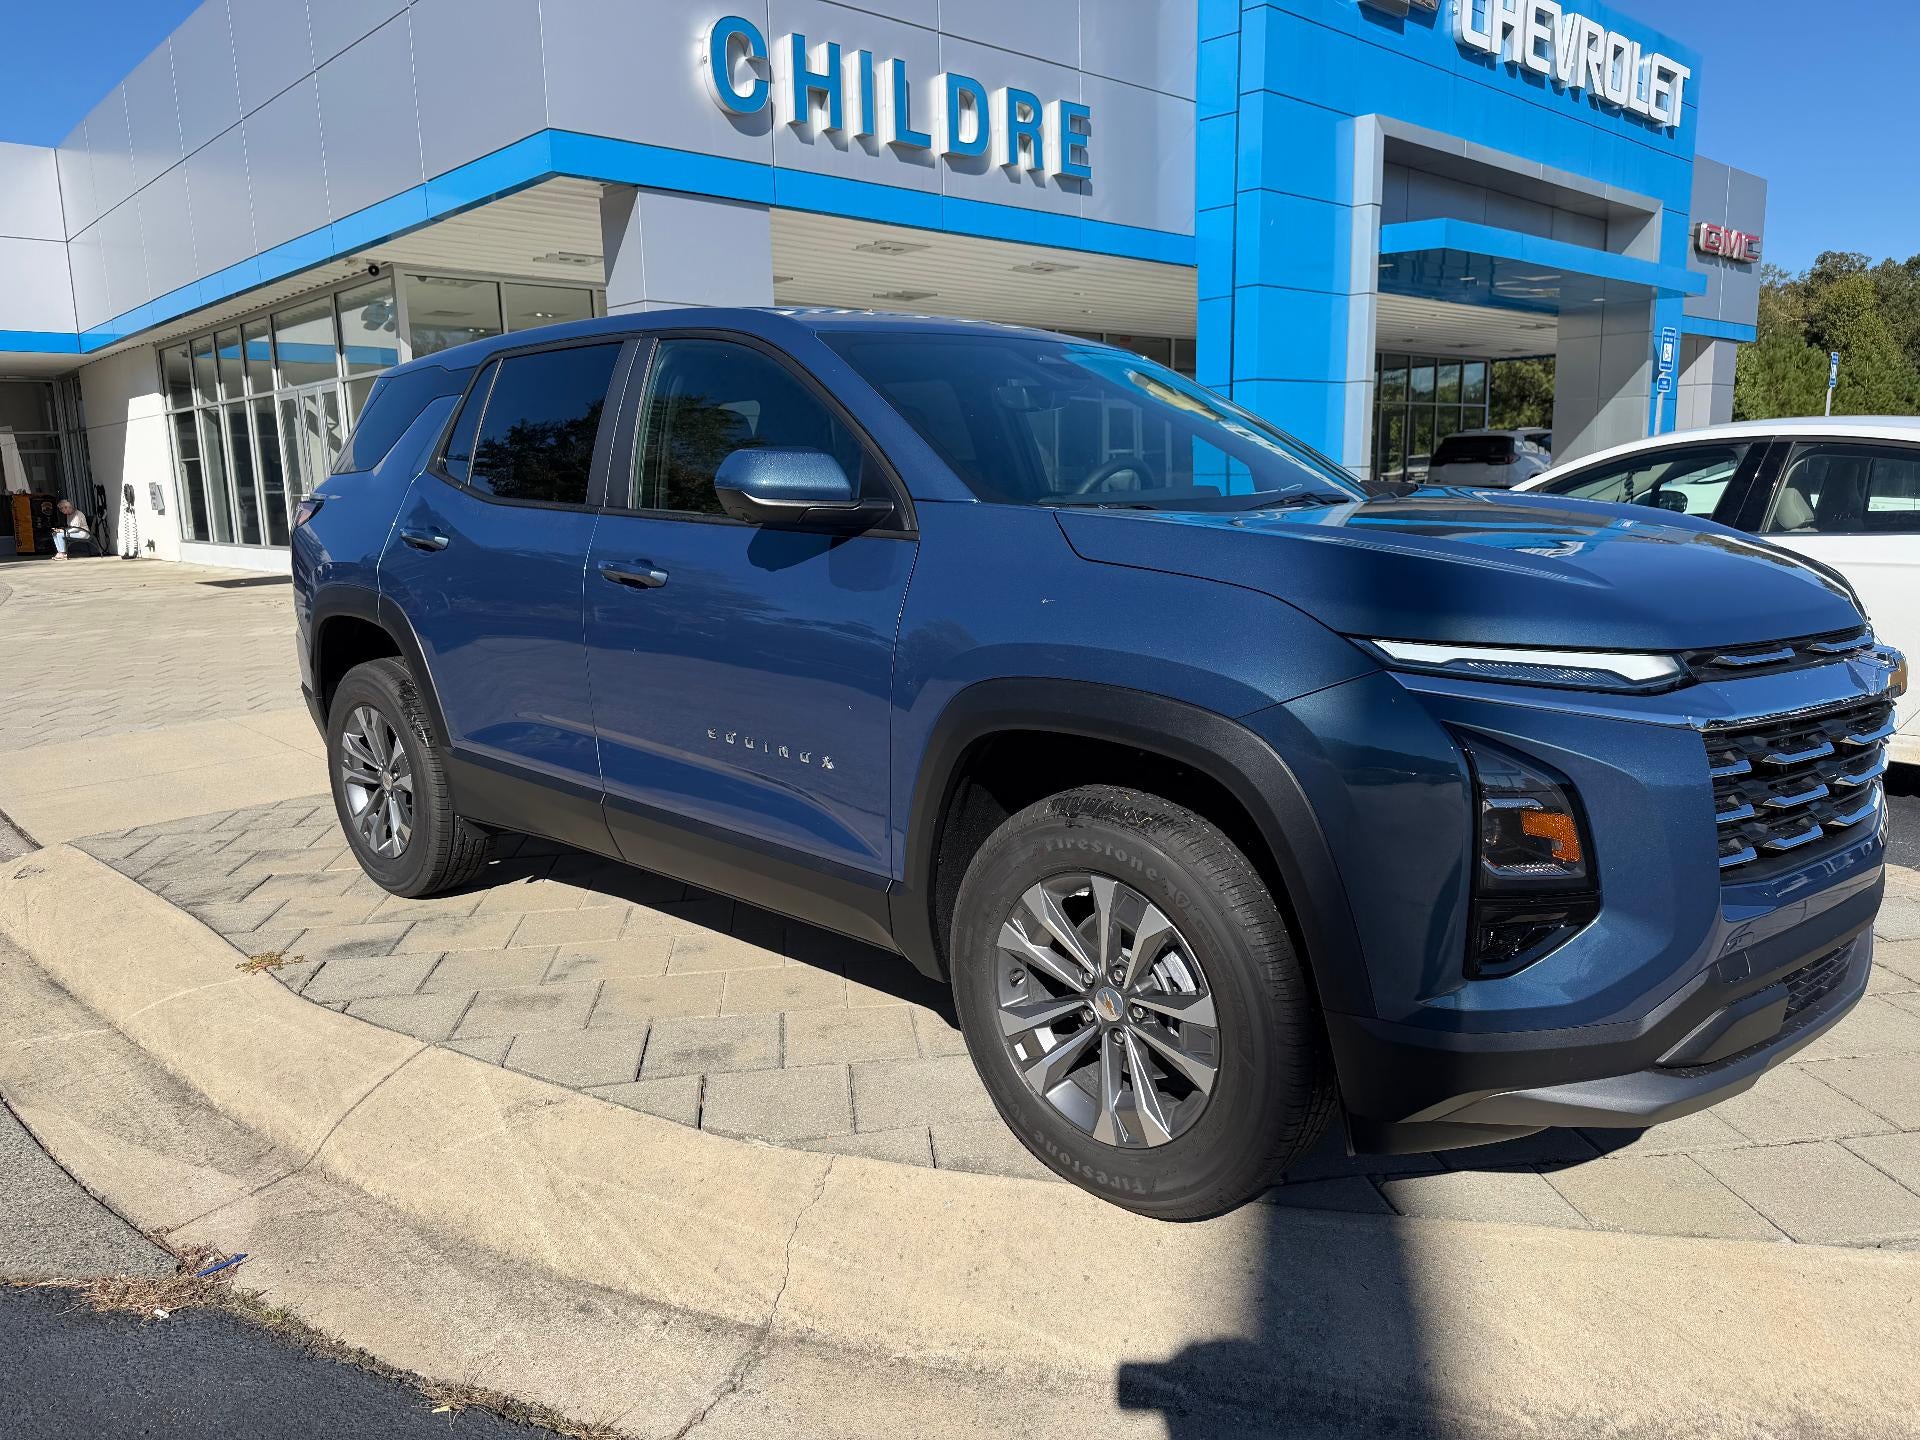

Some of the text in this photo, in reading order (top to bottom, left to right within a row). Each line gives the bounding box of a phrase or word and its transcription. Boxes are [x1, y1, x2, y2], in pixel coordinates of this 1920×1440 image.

[704, 15, 1092, 180] CHILDRE
[1699, 222, 1760, 263] GMC
[707, 728, 834, 769] EQUINOX
[1045, 837, 1158, 881] Firestone
[1033, 1129, 1147, 1195] Firestone
